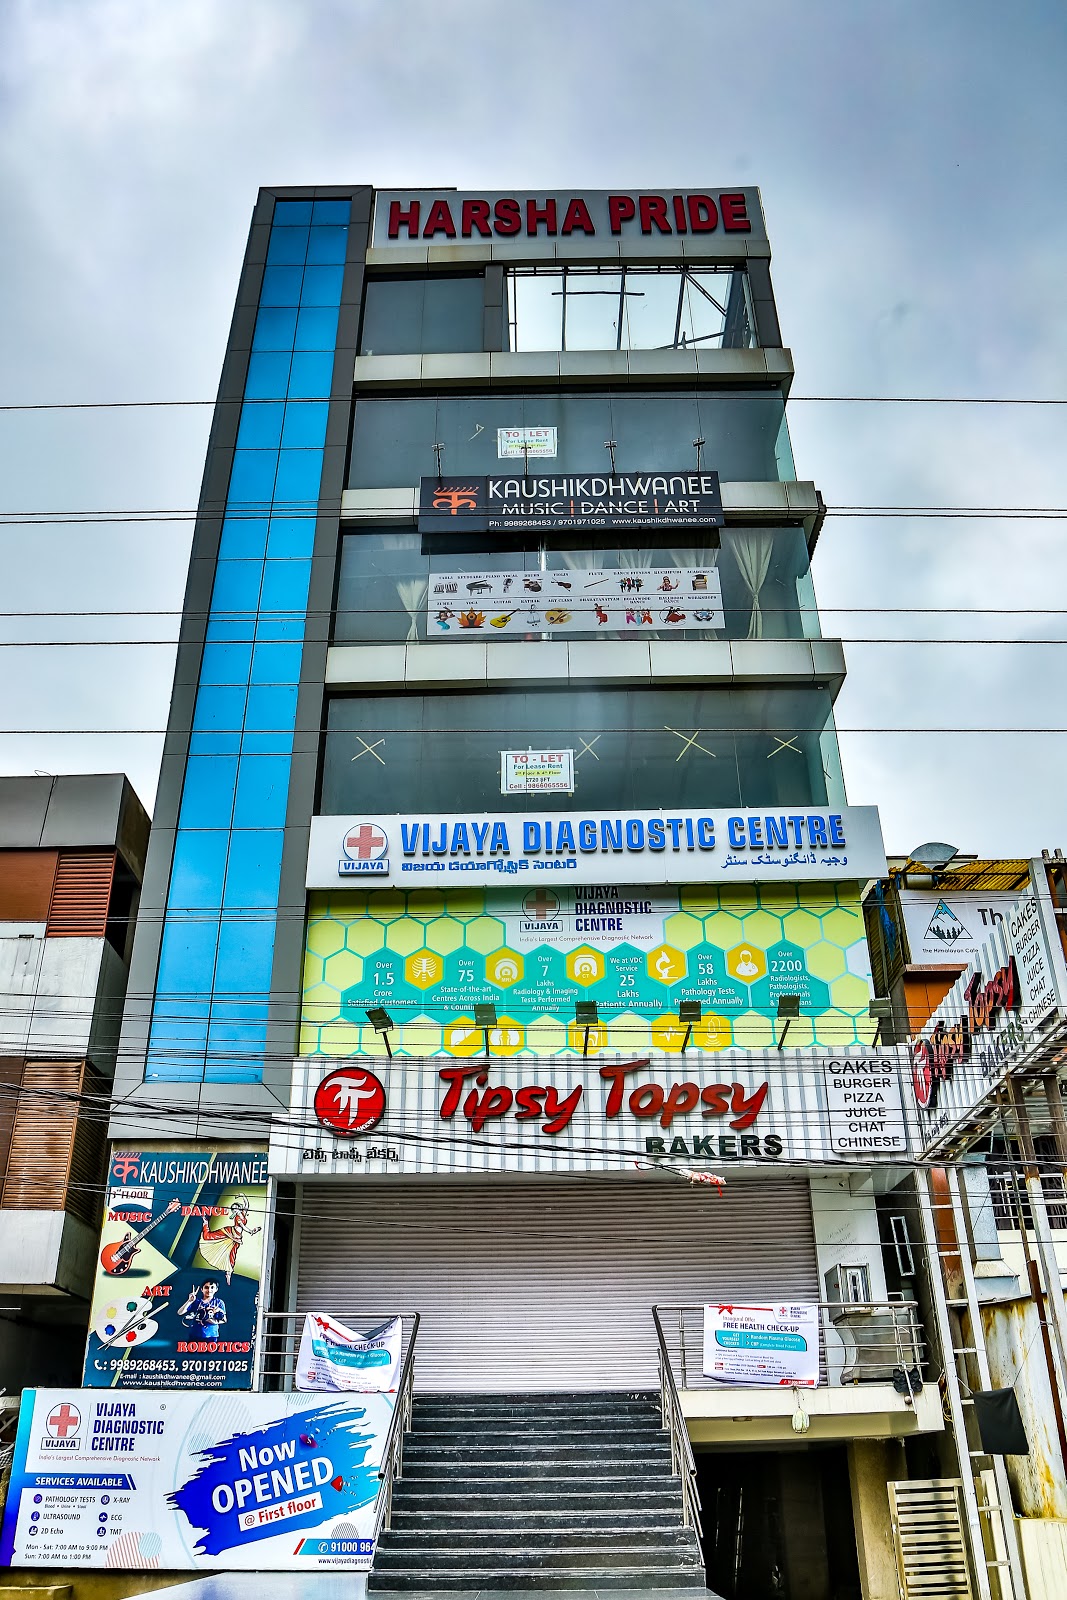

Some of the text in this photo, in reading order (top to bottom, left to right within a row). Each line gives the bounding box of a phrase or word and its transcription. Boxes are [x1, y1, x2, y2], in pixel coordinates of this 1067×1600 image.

[388, 194, 752, 238] HARSHA PRIDE
[488, 476, 714, 499] KAUSHIKDHWANEE
[502, 500, 700, 515] MUSIC DANCE ART
[401, 814, 846, 856] VIJAYA DIAGNOSTIC CENTRE
[344, 861, 384, 870] VIJAYA
[575, 887, 618, 899] VIJAYA
[575, 901, 652, 915] DIAGNOSTIC
[1011, 897, 1037, 938] CAKES
[576, 918, 623, 931] CENTRE
[1016, 919, 1040, 955] BURGER
[1022, 942, 1041, 968] PIZZA
[541, 966, 549, 976] 7
[698, 963, 714, 975] 58
[771, 961, 802, 972] 2200
[1026, 957, 1044, 985] JUICE
[373, 973, 394, 986] 1.5
[458, 970, 474, 982] 75
[620, 974, 635, 986] 25
[552, 987, 578, 995] Imaging
[681, 988, 716, 996] Pathology
[1030, 976, 1046, 1001] CHAT
[712, 997, 744, 1005] Annually
[964, 956, 1018, 1035] Topsy
[629, 1000, 663, 1009] Annually
[1029, 989, 1056, 1024] CHINESE
[828, 1060, 893, 1074] CAKES
[833, 1078, 892, 1089] BURGER
[438, 1064, 582, 1134] Tipsy
[599, 1058, 769, 1130] Topsy
[844, 1092, 884, 1103] PIZZA
[845, 1107, 887, 1118] JUICE
[848, 1122, 885, 1133] CHAT
[646, 1134, 784, 1157] BAKERS
[838, 1136, 901, 1148] CHINESE
[140, 1161, 268, 1184] KAUSHIKDHWANEE
[108, 1211, 152, 1222] MUSIC
[181, 1205, 229, 1216] DANCE
[142, 1285, 172, 1297] ART
[740, 1323, 765, 1331] HEALTH
[766, 1324, 799, 1333] CHECK-UP
[177, 1341, 250, 1353] ROBOTICS
[110, 1359, 248, 1372] 9989268453, 9701971025
[96, 1403, 136, 1417] VIJAYA
[93, 1420, 164, 1435] DIAGNOSTIC
[91, 1437, 135, 1451] CENTRE
[35, 1477, 122, 1486] SERVICES AVAILABLE
[212, 1457, 334, 1514] OPENED
[244, 1498, 316, 1526] @ First floor
[331, 1542, 357, 1552] 91000
